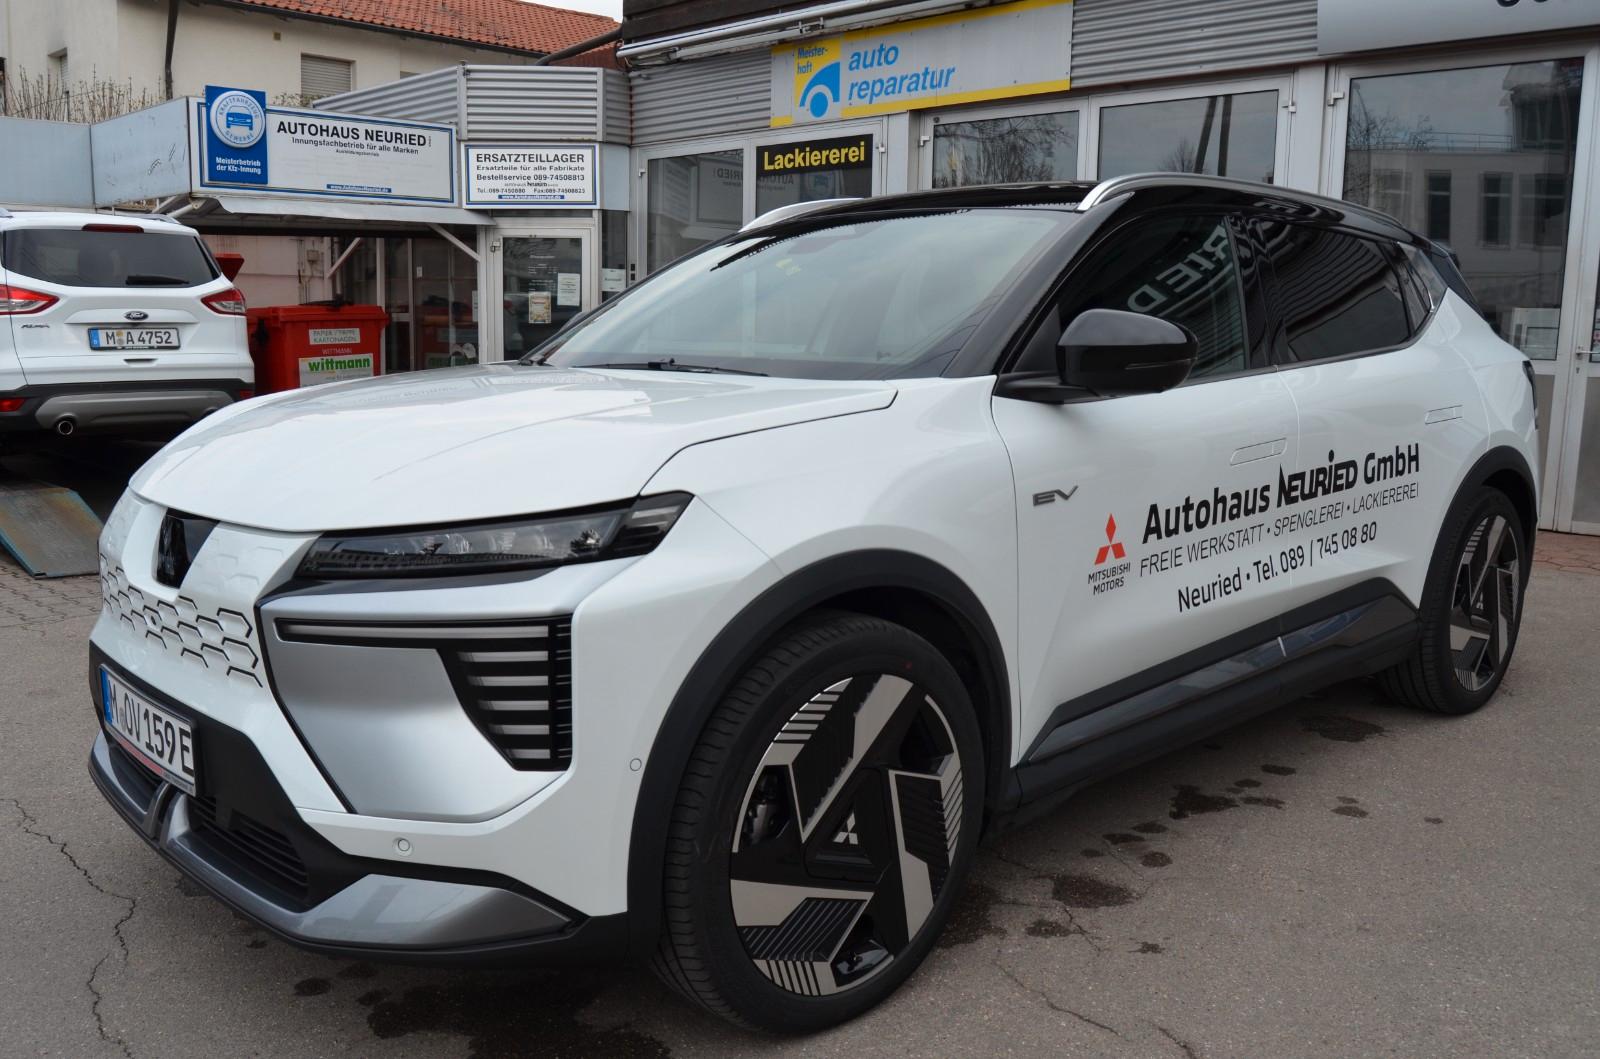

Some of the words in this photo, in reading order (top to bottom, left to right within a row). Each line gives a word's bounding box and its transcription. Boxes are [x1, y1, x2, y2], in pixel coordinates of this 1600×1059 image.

[848, 43, 899, 71] auto
[848, 66, 956, 104] reparatur
[277, 121, 360, 140] AUTOHAUS
[364, 128, 427, 147] NEURIED
[292, 137, 365, 150] Innungsfachbetrieb
[366, 143, 377, 151] für
[393, 146, 419, 155] Marken
[215, 156, 261, 167] Meisterbetrieb
[476, 153, 585, 163] ERSATZTEILLAGER
[764, 141, 865, 171] Lackiererei
[227, 165, 262, 175] Kfz-Innung
[106, 332, 116, 345] M
[126, 332, 135, 345] A
[137, 331, 173, 345] 4752
[308, 357, 371, 372] wittmann
[1032, 485, 1079, 507] EV
[1142, 484, 1271, 545] Autohaus
[1363, 443, 1420, 484] GmbH
[1139, 546, 1183, 577] FREIE
[1187, 523, 1265, 569] WERKSTATT
[1273, 501, 1345, 537] SPENGLEREI
[1352, 482, 1419, 514] LACKIEREREI
[1087, 561, 1131, 585] MITSUBISHI
[1177, 566, 1242, 613] Neuried
[1253, 555, 1278, 584] Tel.
[1279, 545, 1305, 574] 089
[1316, 532, 1339, 560] 745
[1341, 525, 1357, 548] 08
[1360, 520, 1377, 544] 80
[1093, 576, 1125, 596] MOTORS
[124, 691, 140, 742] OV
